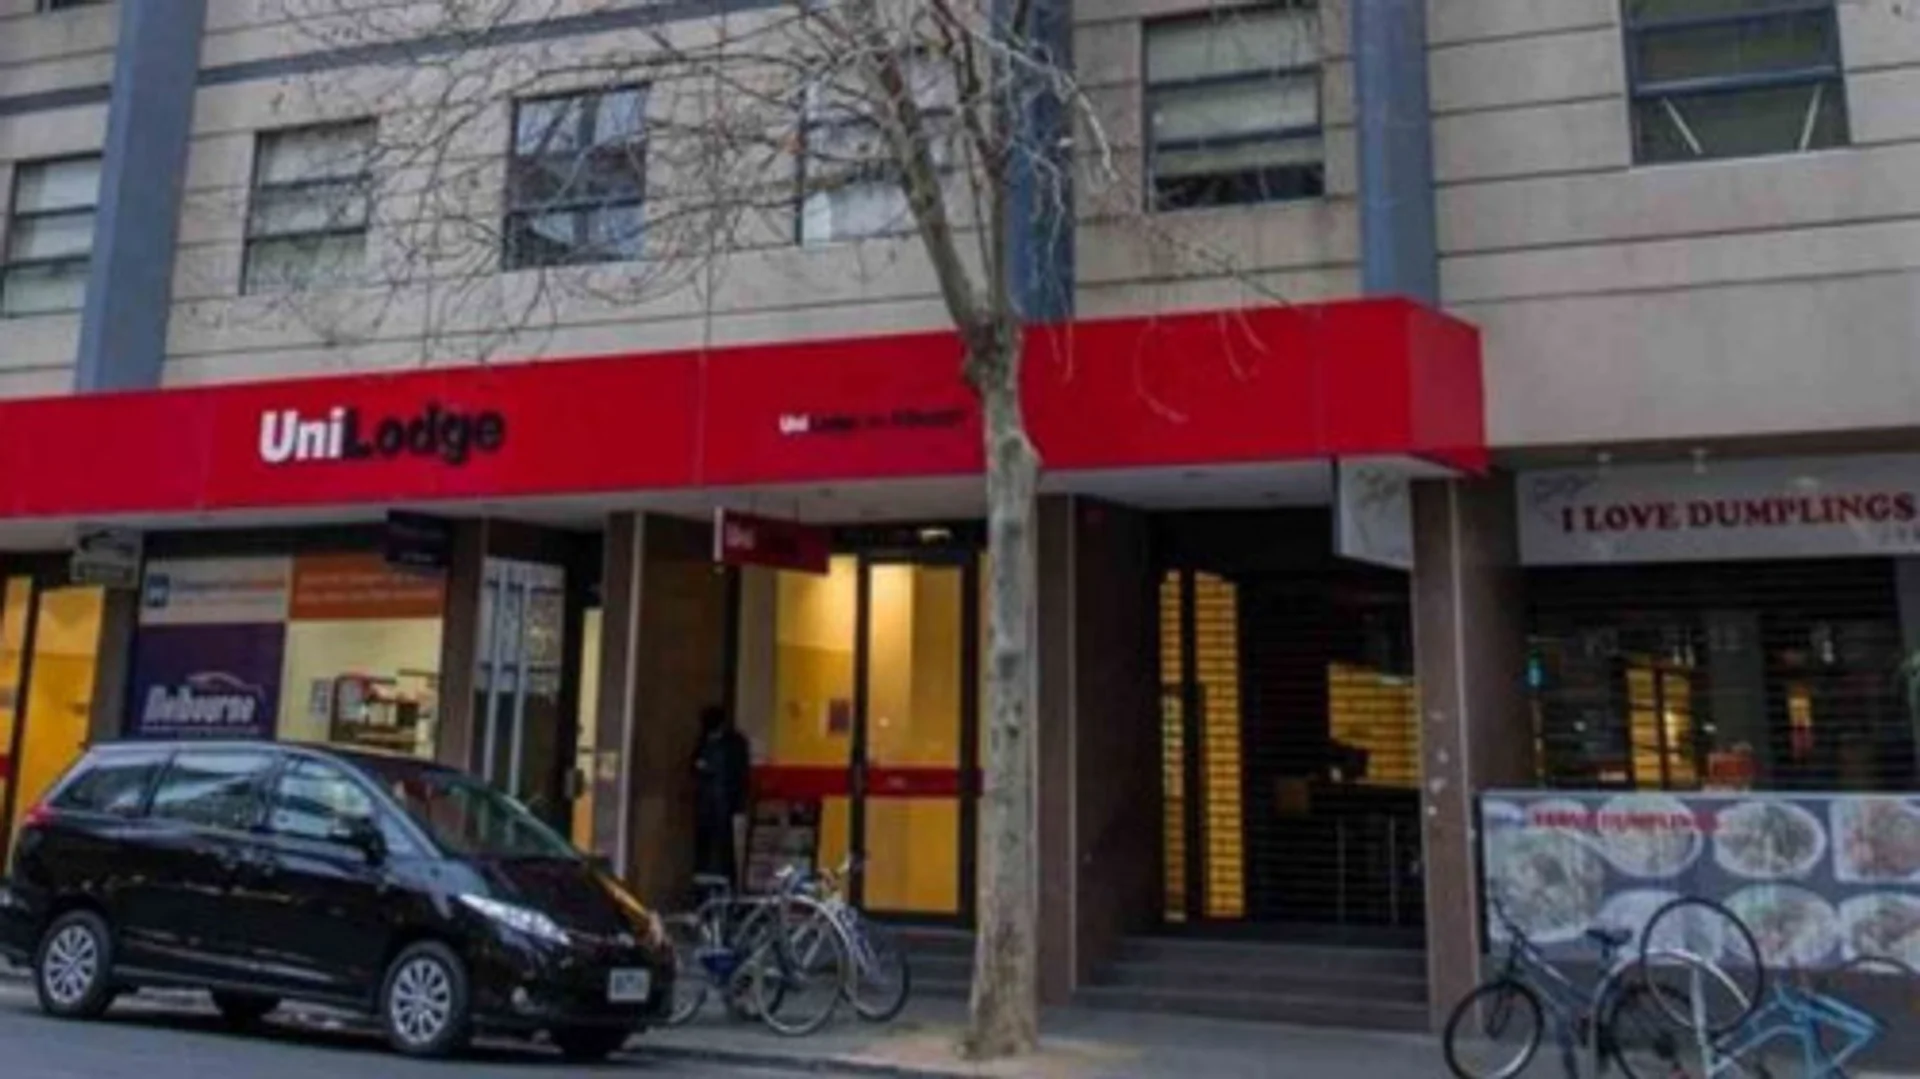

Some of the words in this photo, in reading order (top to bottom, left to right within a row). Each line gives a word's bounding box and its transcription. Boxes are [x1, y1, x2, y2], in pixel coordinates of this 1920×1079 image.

[259, 404, 505, 466] UniLodge
[1562, 506, 1574, 533] I
[1584, 501, 1680, 533] LOVE
[1687, 492, 1916, 528] DUMPLINGS
